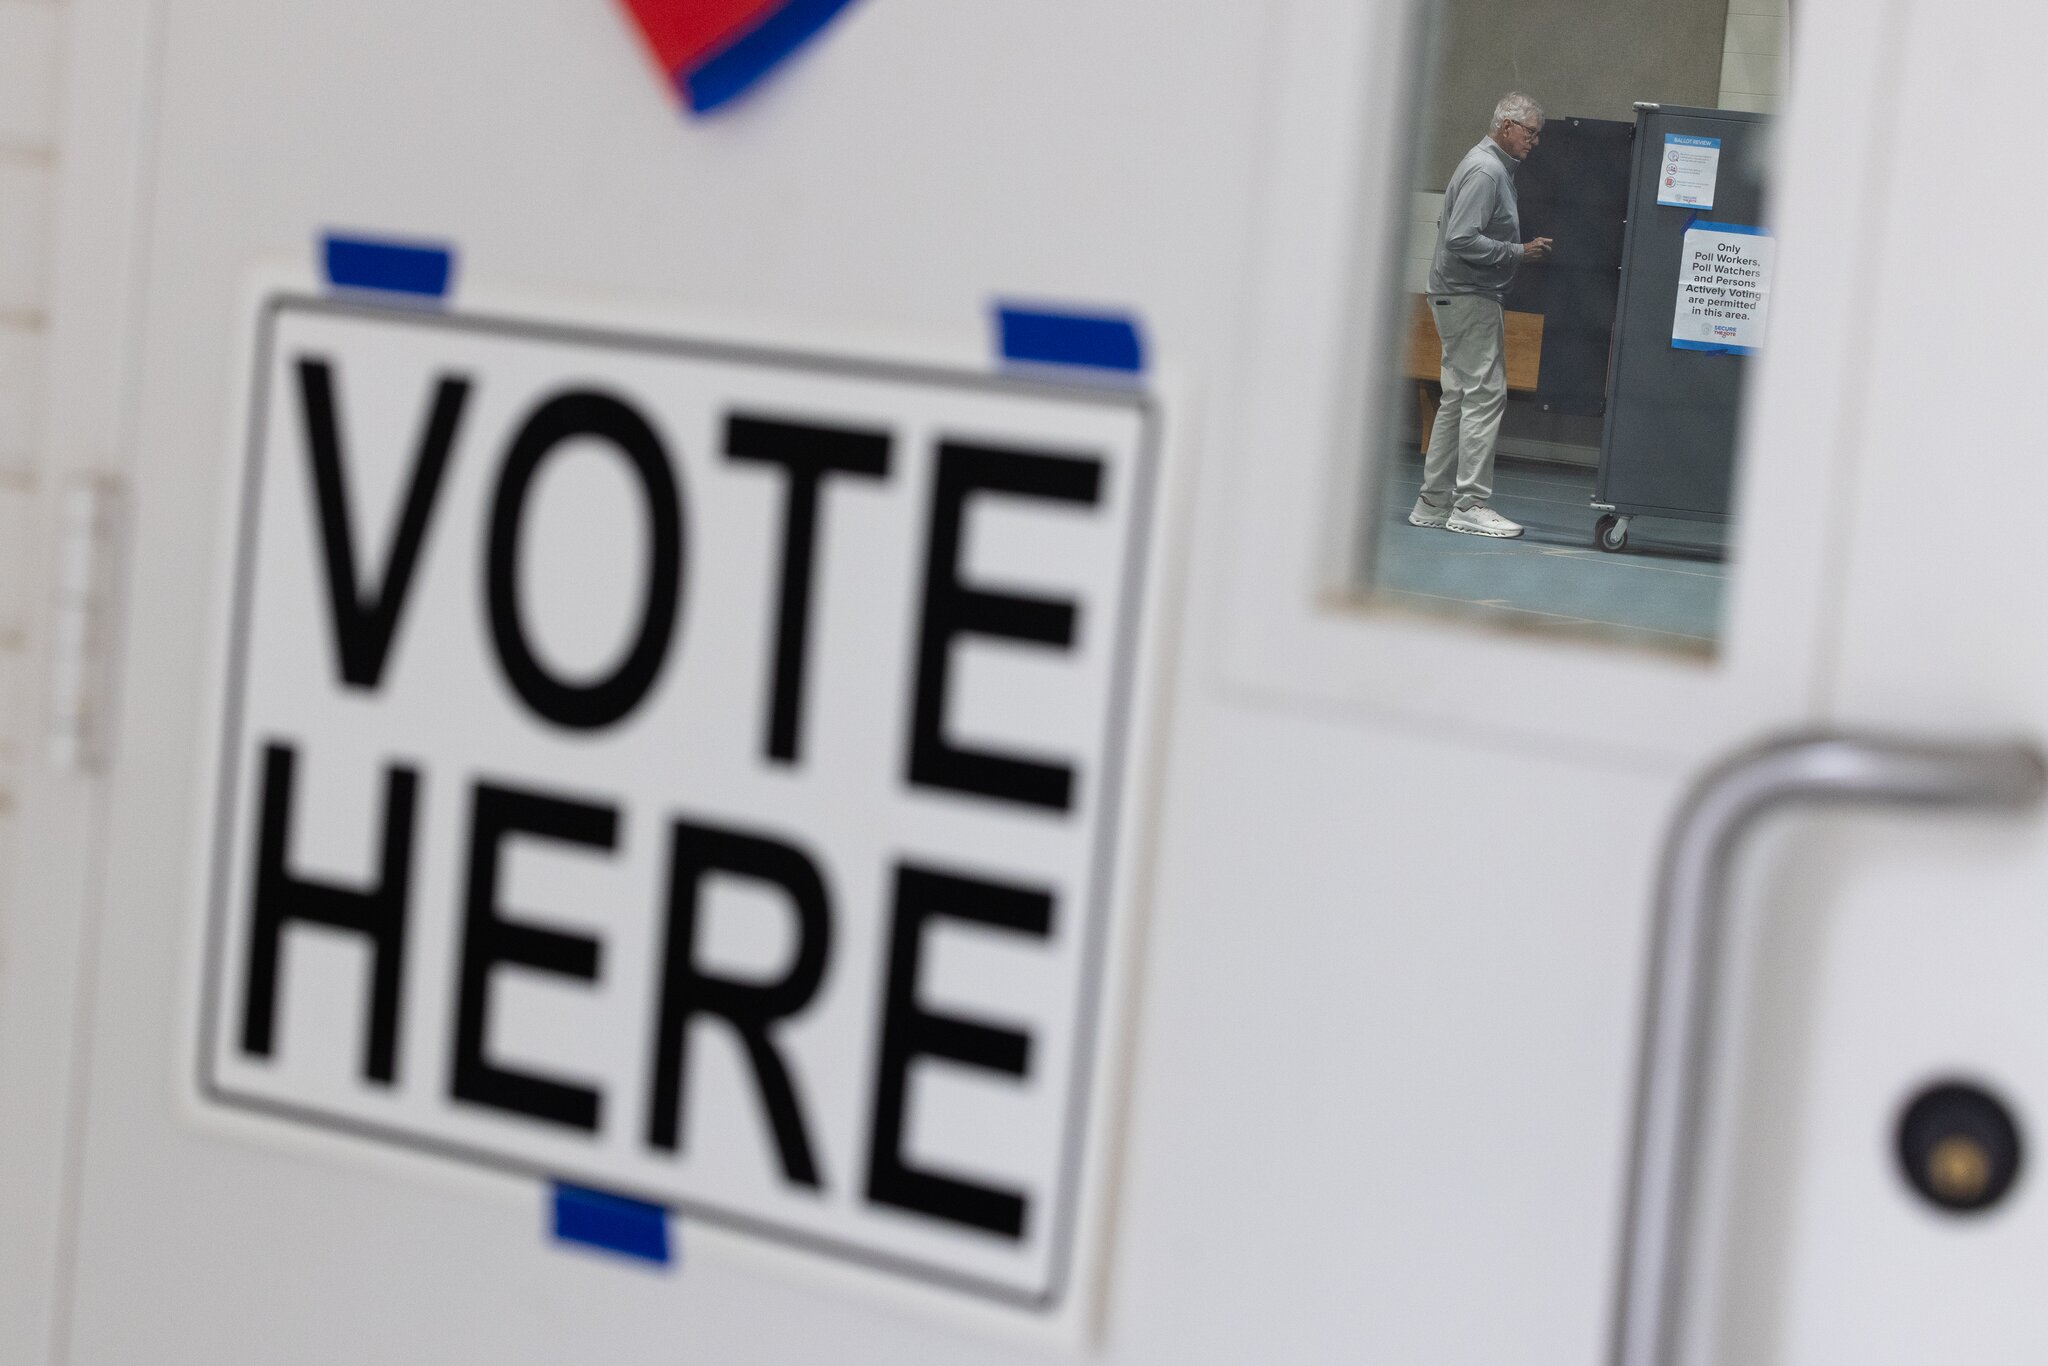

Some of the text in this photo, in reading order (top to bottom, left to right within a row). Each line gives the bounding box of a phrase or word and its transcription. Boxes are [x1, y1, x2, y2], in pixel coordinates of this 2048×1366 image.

[1717, 243, 1741, 254] Only
[1695, 252, 1760, 267] Poll Workers,
[1692, 263, 1761, 277] Poll Watchers
[1694, 275, 1756, 288] and Persons
[1686, 284, 1761, 301] Actively Voting
[1708, 298, 1756, 310] permitted
[1692, 307, 1750, 320] in this area.
[294, 355, 1108, 817] VOTE
[237, 740, 1058, 1244] HERE
